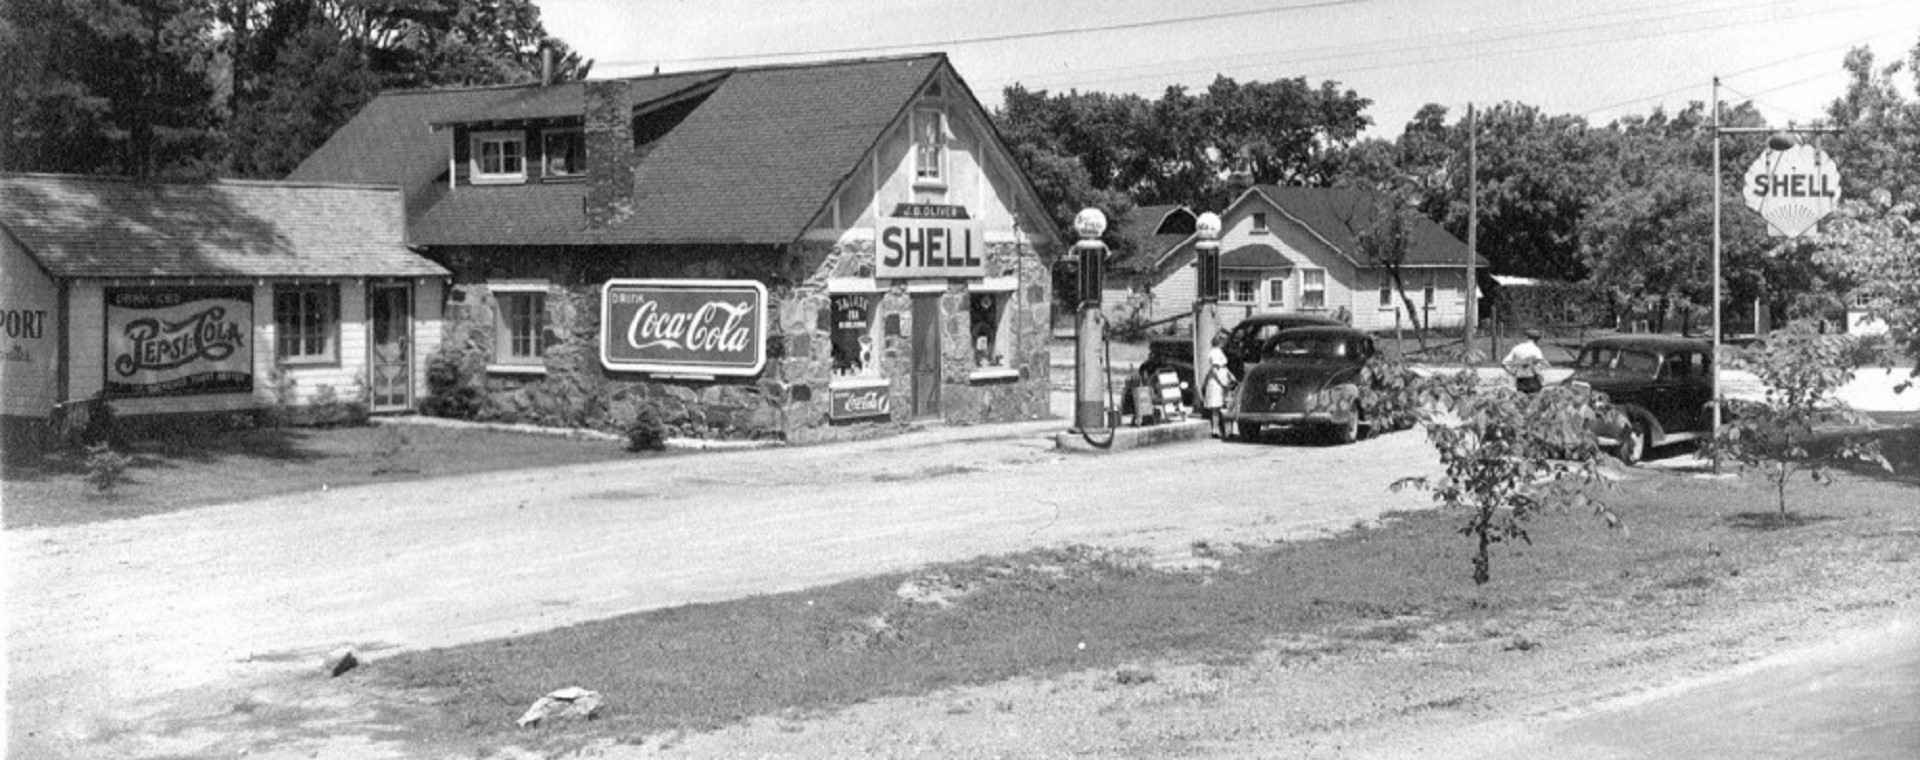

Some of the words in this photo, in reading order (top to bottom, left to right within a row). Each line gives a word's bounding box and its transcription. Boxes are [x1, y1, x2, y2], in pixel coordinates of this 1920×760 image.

[1753, 174, 1835, 197] SHELL
[882, 226, 981, 267] SHELL
[611, 293, 645, 304] DRINK
[627, 300, 756, 352] Coca-Cola
